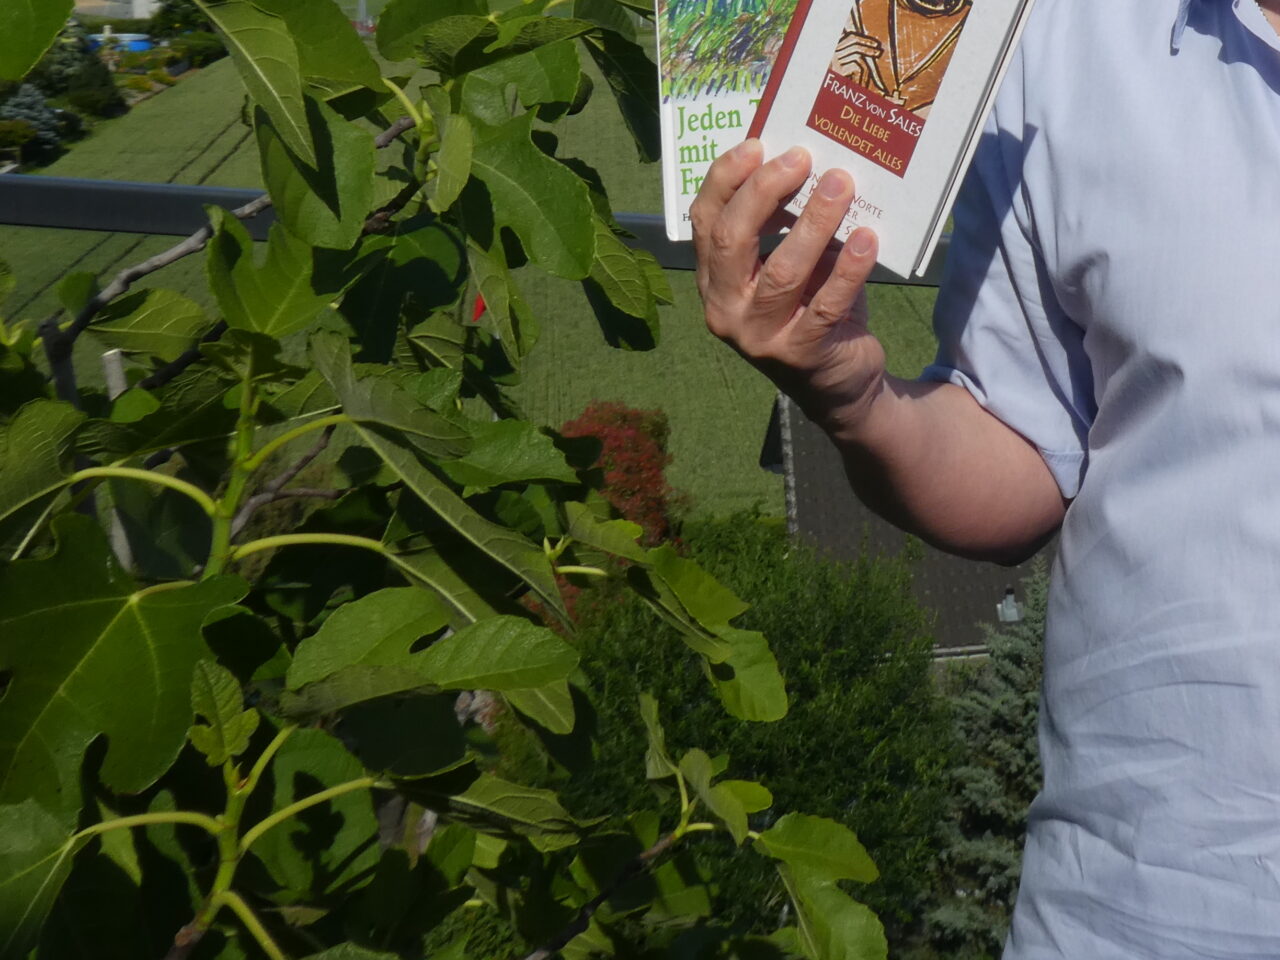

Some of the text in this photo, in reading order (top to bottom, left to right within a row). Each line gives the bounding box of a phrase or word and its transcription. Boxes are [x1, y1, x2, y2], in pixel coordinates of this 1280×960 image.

[677, 102, 743, 140] Jeden
[823, 72, 867, 108] FRANZ
[887, 108, 922, 137] SALES
[679, 135, 718, 164] mit
[814, 113, 903, 170] VOLLENDET ALLES
